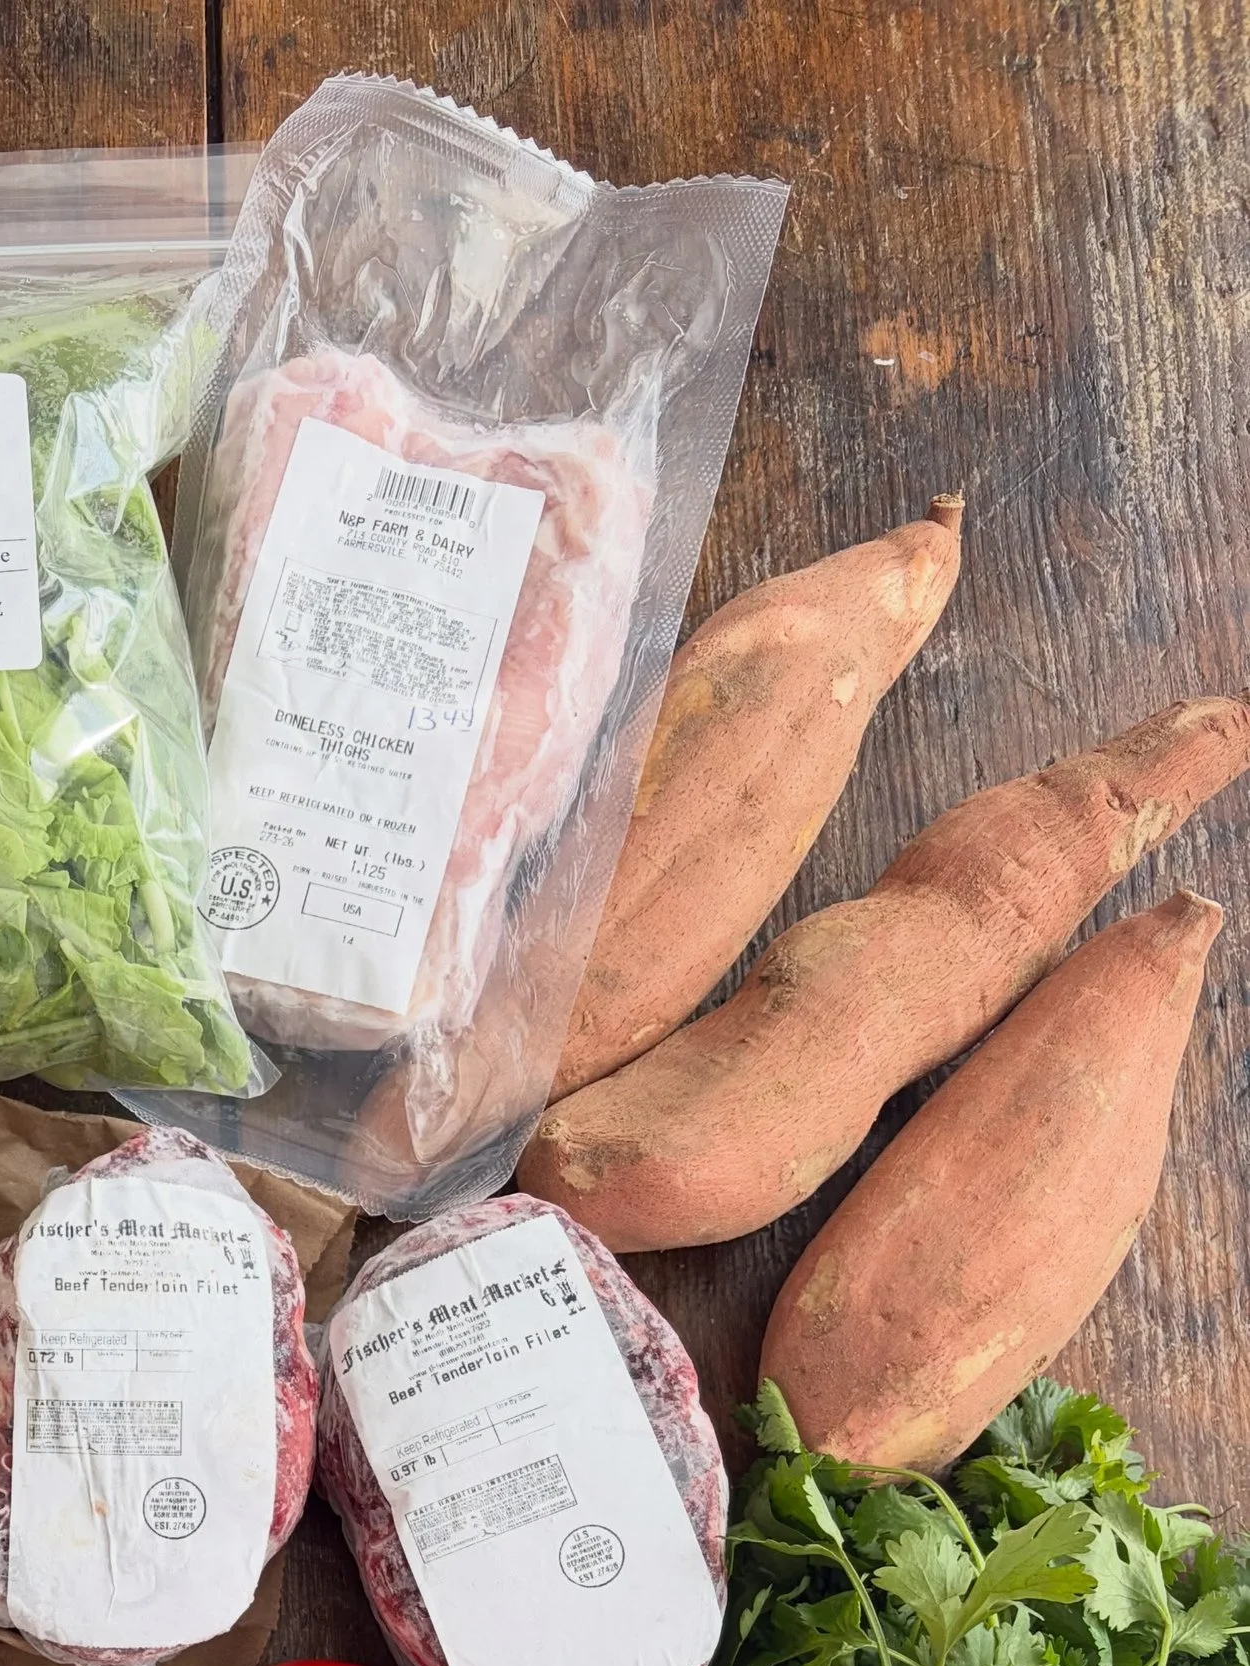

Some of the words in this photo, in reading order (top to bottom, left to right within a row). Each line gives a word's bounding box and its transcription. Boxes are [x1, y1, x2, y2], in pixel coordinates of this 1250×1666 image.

[339, 509, 366, 528] N&P
[372, 519, 409, 538] FARM
[415, 528, 425, 542] &
[431, 532, 475, 559] DAIRY
[370, 532, 408, 547] COUNTY
[412, 542, 437, 557] ROAD
[275, 709, 344, 739] BONELESS
[352, 730, 415, 756] CHICKEN
[320, 737, 370, 762] THIGHS
[248, 785, 276, 799] KEEP
[280, 791, 355, 820] REFRIGERATED
[359, 812, 373, 824] OR
[377, 818, 417, 834] FROZEN
[325, 835, 348, 851] NET
[210, 850, 275, 892] SPECTED
[351, 860, 388, 881] 1.125
[221, 875, 253, 901] U.S.
[343, 902, 362, 917] USA
[115, 1219, 165, 1240] Meat
[171, 1221, 235, 1244] Market
[54, 1278, 89, 1293] Beef
[100, 1277, 188, 1294] Tenderloin
[197, 1279, 239, 1296] Filet
[341, 1319, 423, 1376] Fischer's
[428, 1297, 478, 1331] Meat
[482, 1265, 551, 1309] Market
[41, 1332, 67, 1347] Keep
[69, 1332, 127, 1348] Refrigerated
[63, 1351, 74, 1364] lb
[388, 1380, 423, 1406] Beef
[432, 1343, 520, 1387] Tenderloin
[525, 1323, 571, 1350] Filet
[396, 1440, 422, 1460] Keep
[422, 1414, 482, 1448] Refrigerated
[424, 1454, 437, 1467] lb
